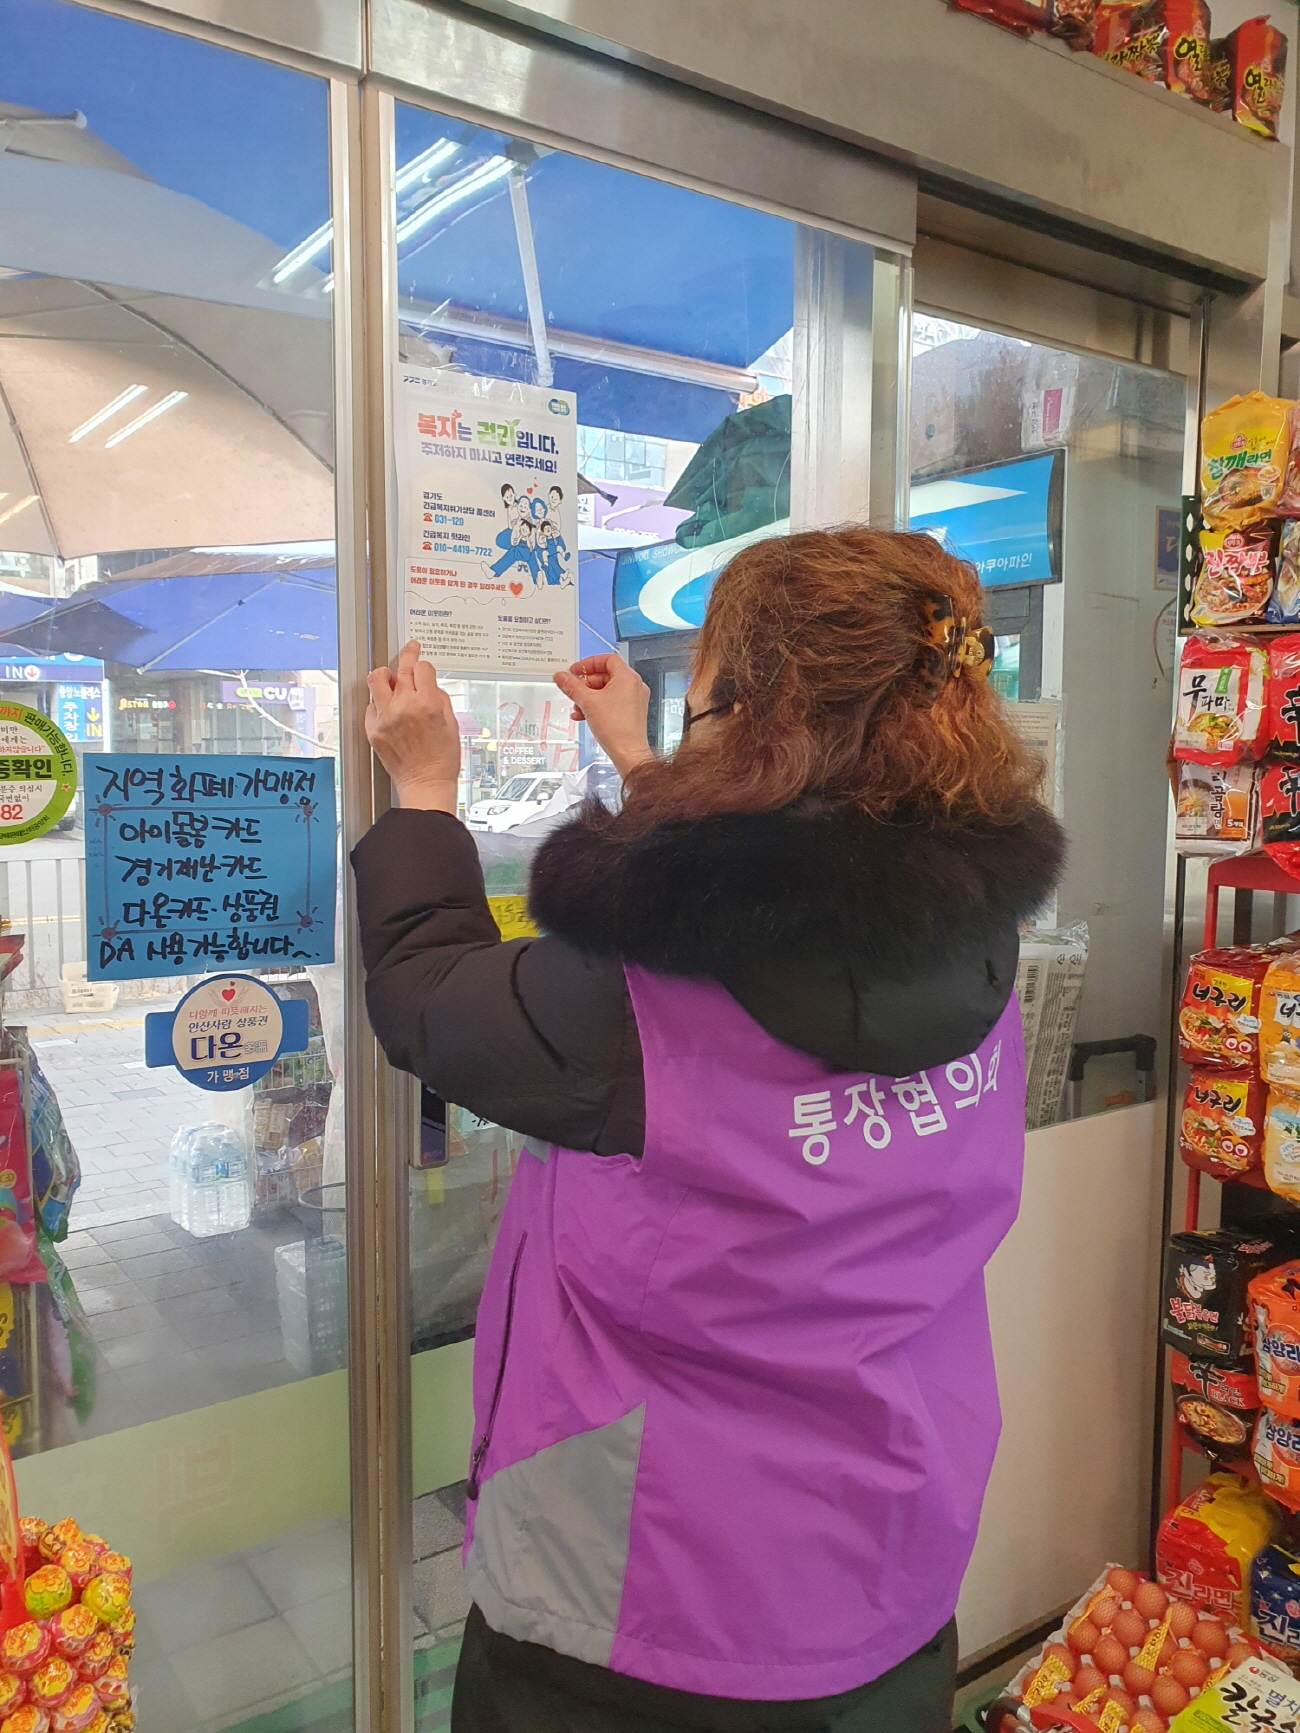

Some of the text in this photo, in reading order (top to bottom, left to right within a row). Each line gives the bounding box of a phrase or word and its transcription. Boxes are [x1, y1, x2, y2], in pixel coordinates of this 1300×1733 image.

[418, 410, 559, 455] 복지는 권리입니다.
[421, 442, 558, 473] 주저하지 마시고 연락주세요!
[1208, 449, 1271, 480] 참깨라면
[423, 491, 443, 501] 경기도
[423, 501, 496, 518] 긴급복지위기상담 콜센터
[434, 514, 464, 526] 031-120
[423, 530, 471, 542] 긴급복지 핫라인
[434, 543, 492, 557] 010-4419-7722
[263, 686, 288, 700] CU
[1182, 674, 1230, 711] 무파마
[1, 725, 18, 734] 미만
[85, 722, 103, 737] IN
[1, 735, 28, 744] 에게는
[503, 747, 534, 755] COFFEE
[503, 757, 546, 765] & DESSERT
[19, 784, 42, 793] 의심시
[1210, 771, 1227, 830] 리곰탕면
[1192, 982, 1247, 1013] 너구리
[189, 1004, 268, 1019] 다함께 따뜻해지는
[189, 1015, 268, 1033] 안산사랑 상품권
[191, 1032, 243, 1061] 다온
[207, 1067, 250, 1083] 가맹점
[1194, 1085, 1242, 1115] 너구리
